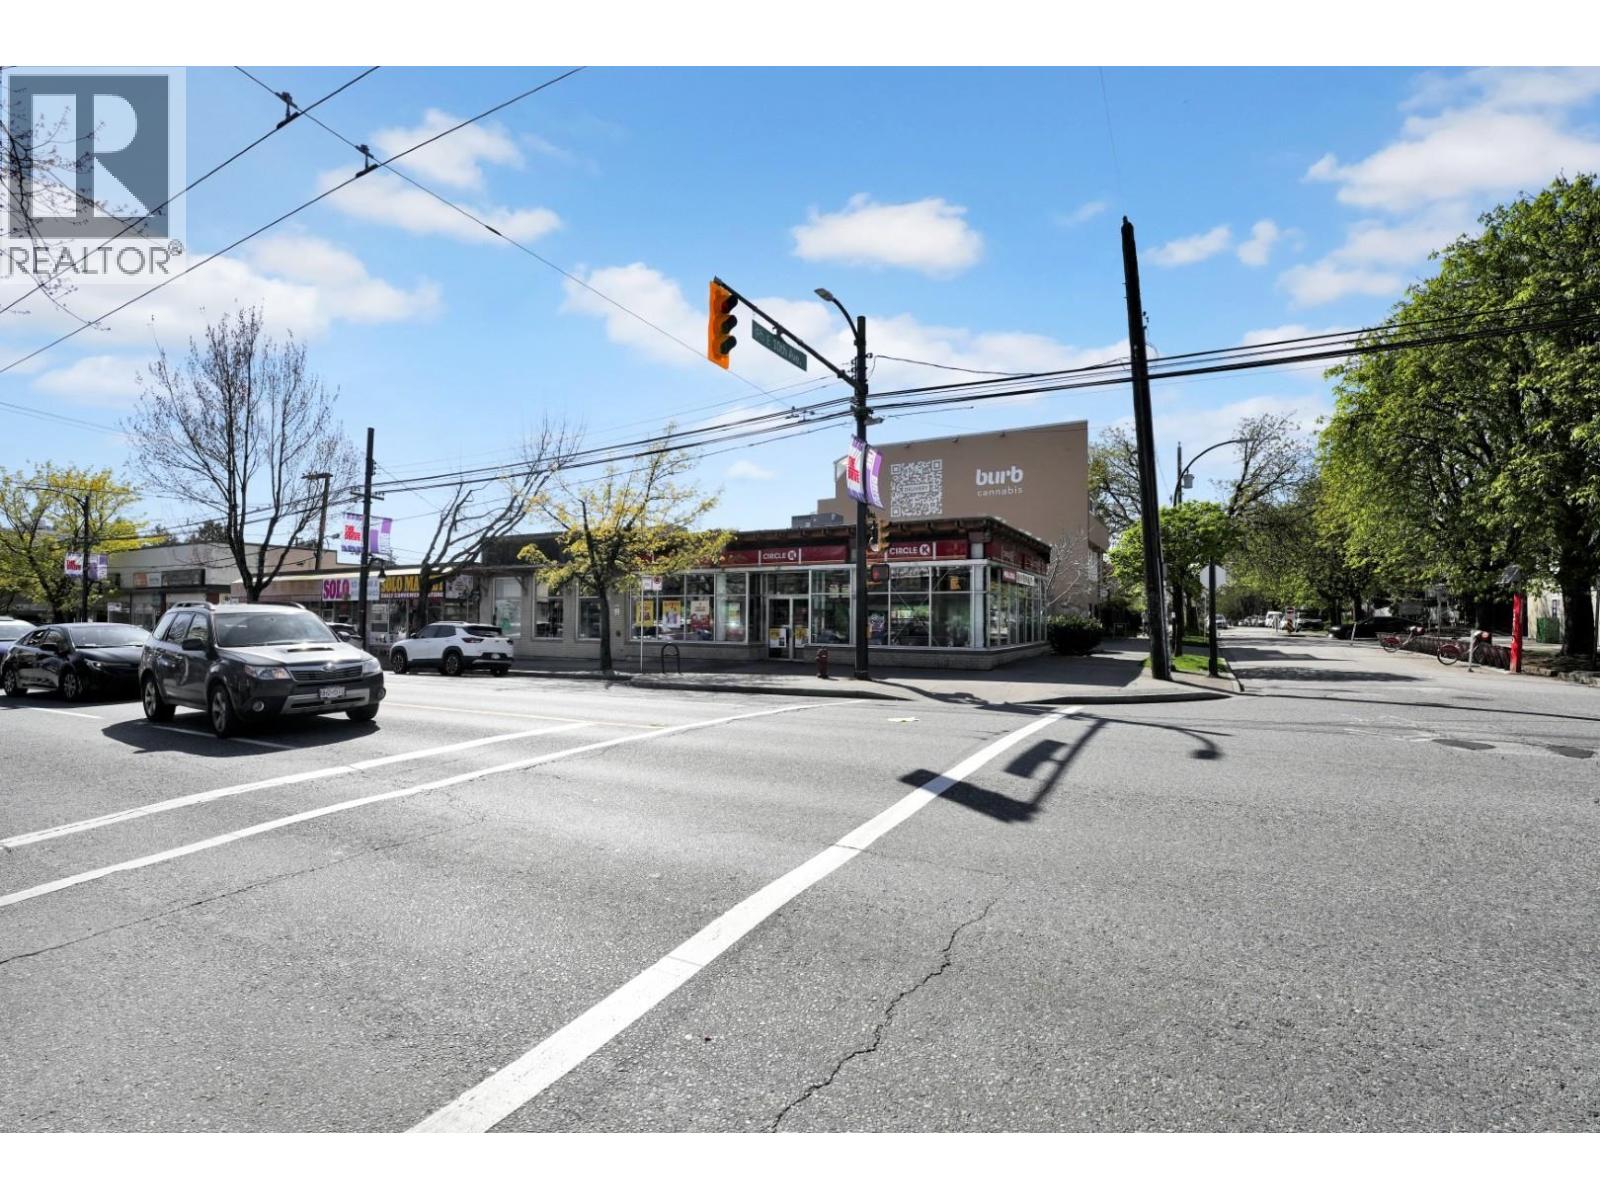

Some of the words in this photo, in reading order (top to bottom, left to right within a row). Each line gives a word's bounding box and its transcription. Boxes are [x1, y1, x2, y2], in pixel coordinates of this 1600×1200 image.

[976, 466, 1023, 485] burb
[977, 486, 1023, 497] cannabis
[763, 552, 786, 560] CIRCLE
[889, 546, 918, 555] CIRCLE
[324, 579, 350, 599] SOLO
[381, 577, 402, 592] SOLO
